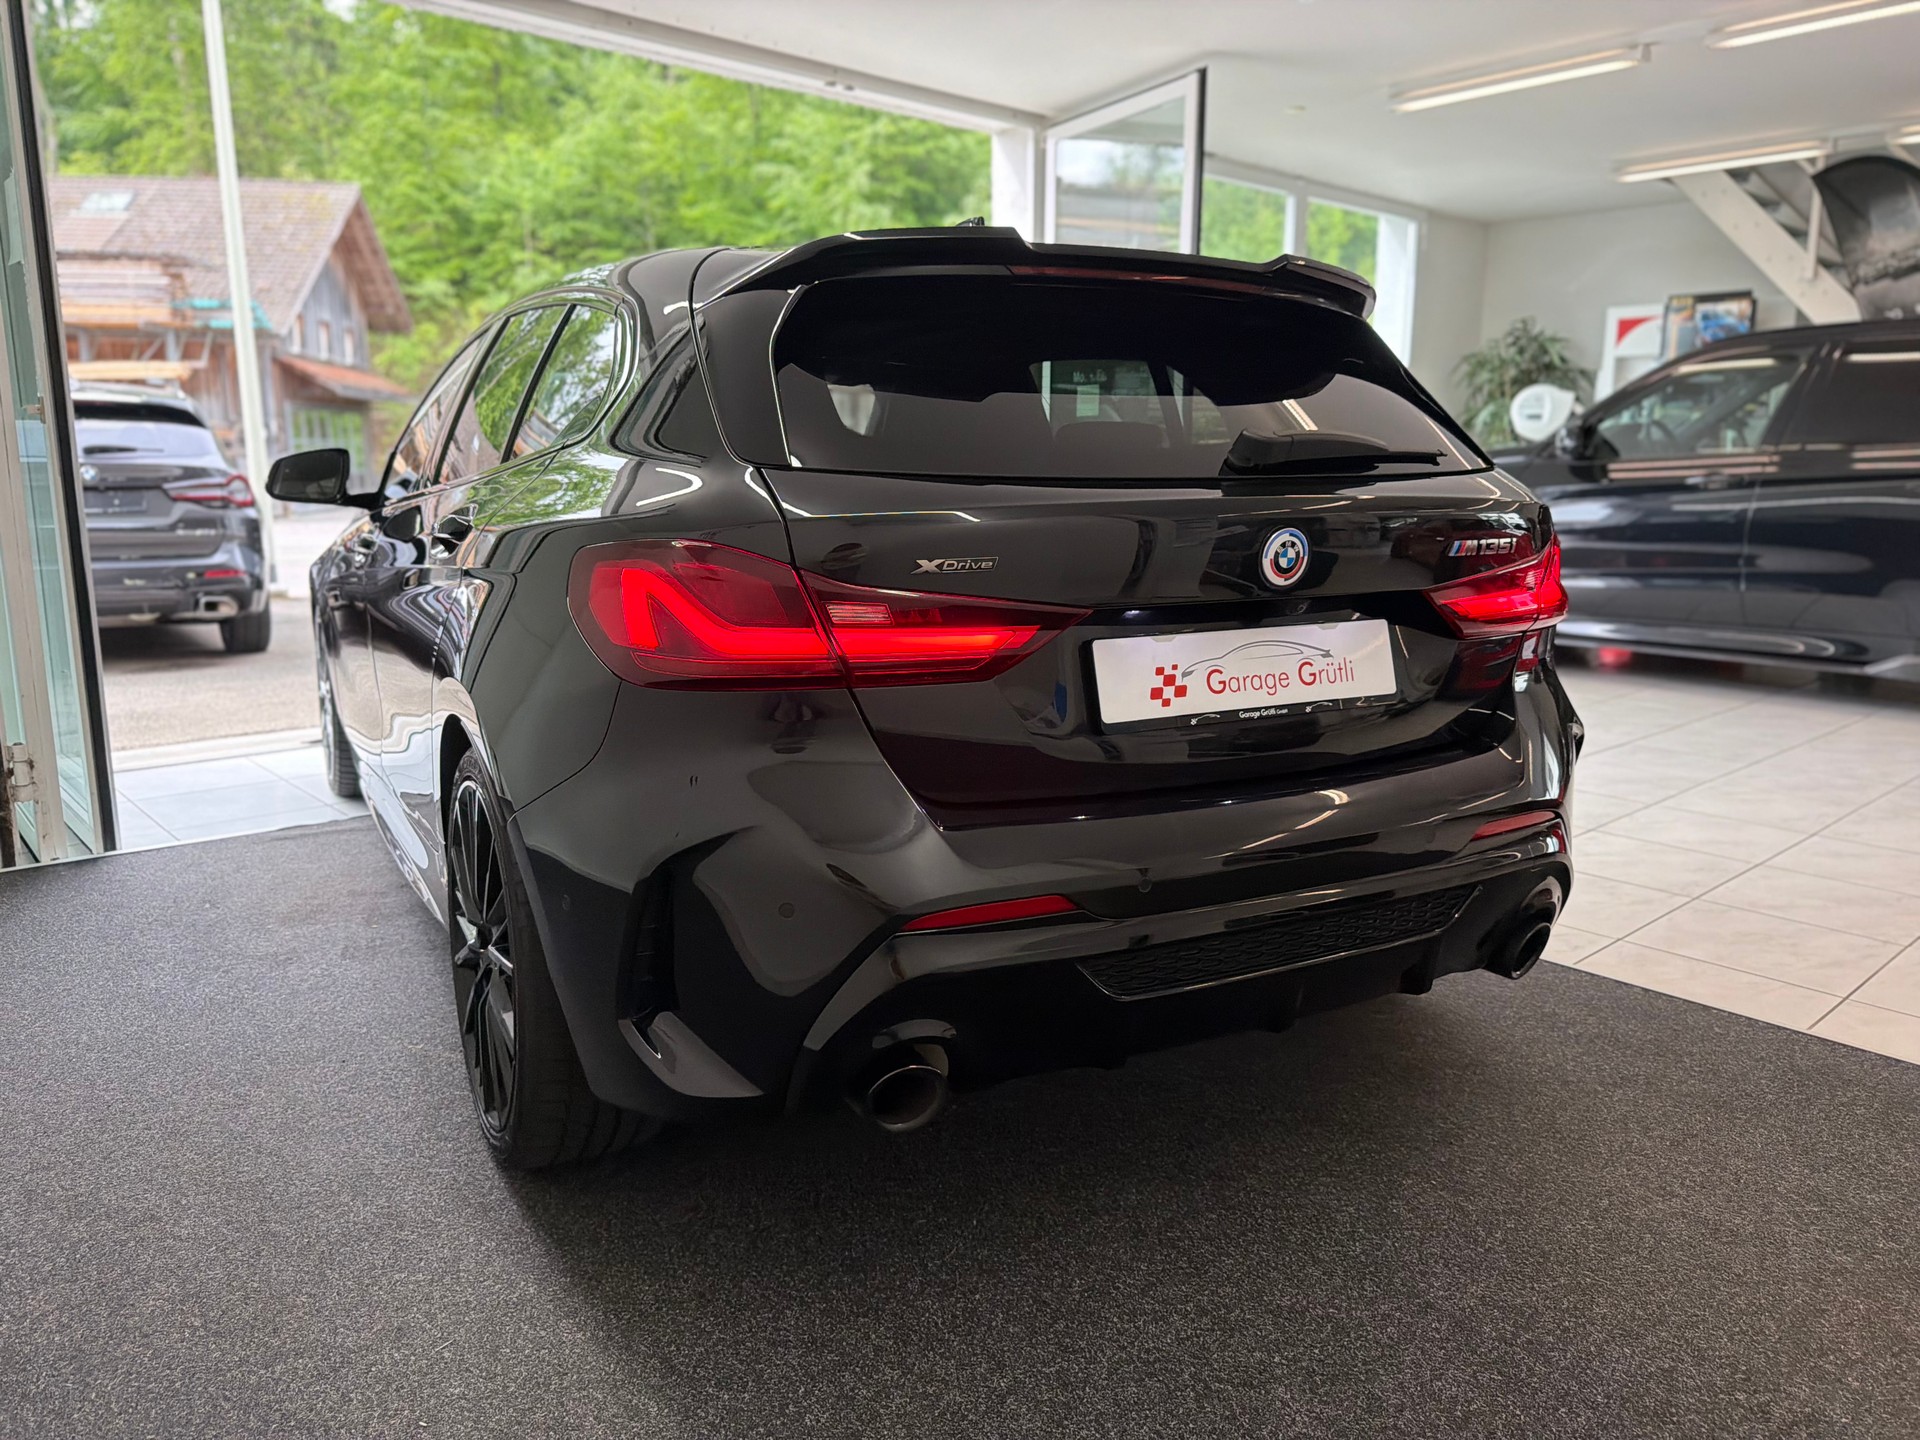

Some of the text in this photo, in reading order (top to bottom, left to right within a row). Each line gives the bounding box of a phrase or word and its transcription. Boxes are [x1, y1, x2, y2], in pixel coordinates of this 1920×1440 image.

[1276, 540, 1300, 553] BMW
[1449, 537, 1518, 556] M135i
[1206, 657, 1355, 696] Garage Grütli
[1238, 710, 1261, 719] Garage
